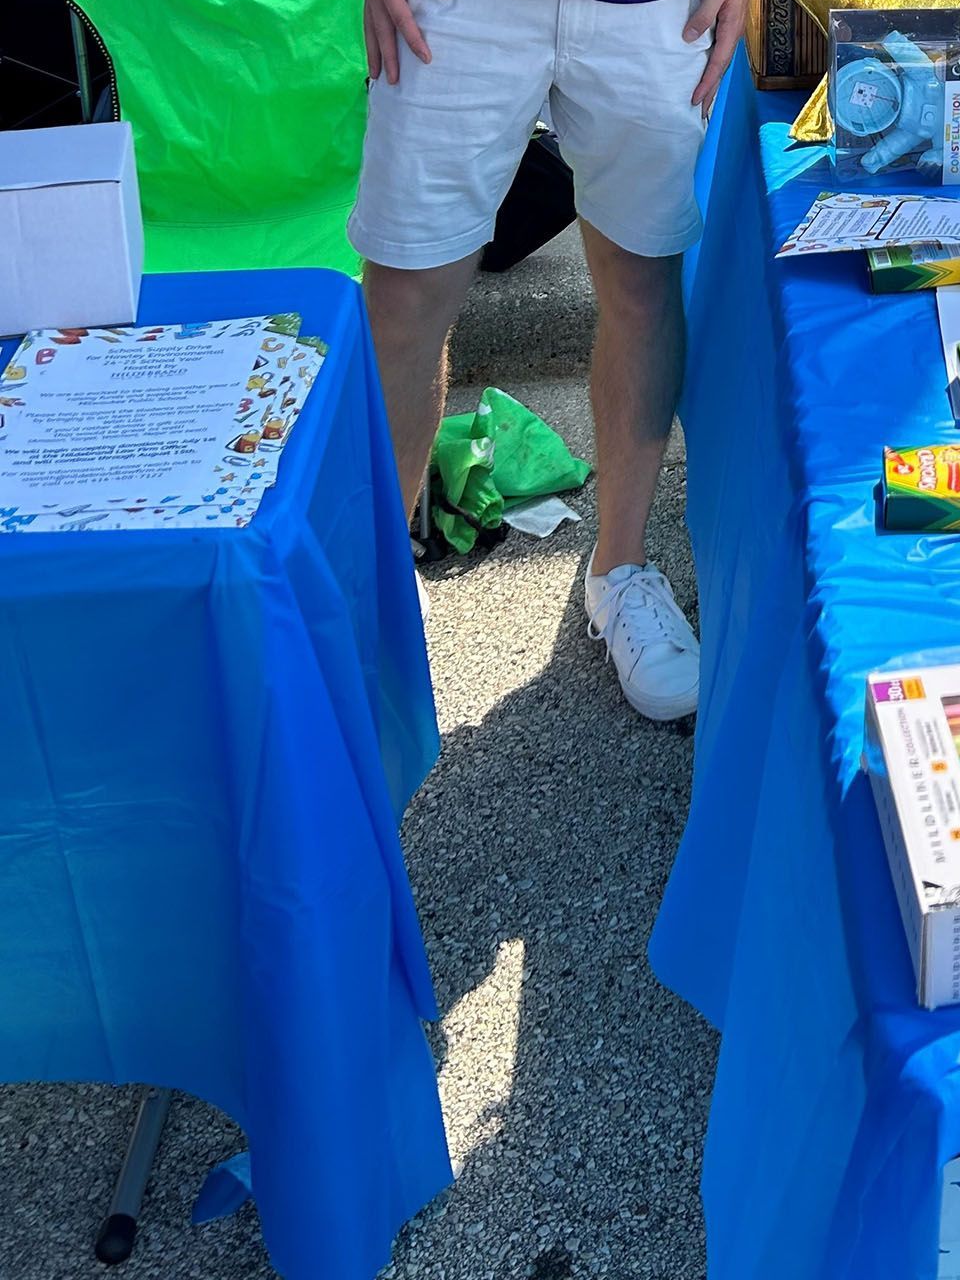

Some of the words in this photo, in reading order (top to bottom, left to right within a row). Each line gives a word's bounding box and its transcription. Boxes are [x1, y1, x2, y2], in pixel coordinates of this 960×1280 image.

[950, 93, 960, 174] CONSTELLATION
[917, 449, 937, 491] CRAYONS
[908, 756, 946, 864] MILDLINER
